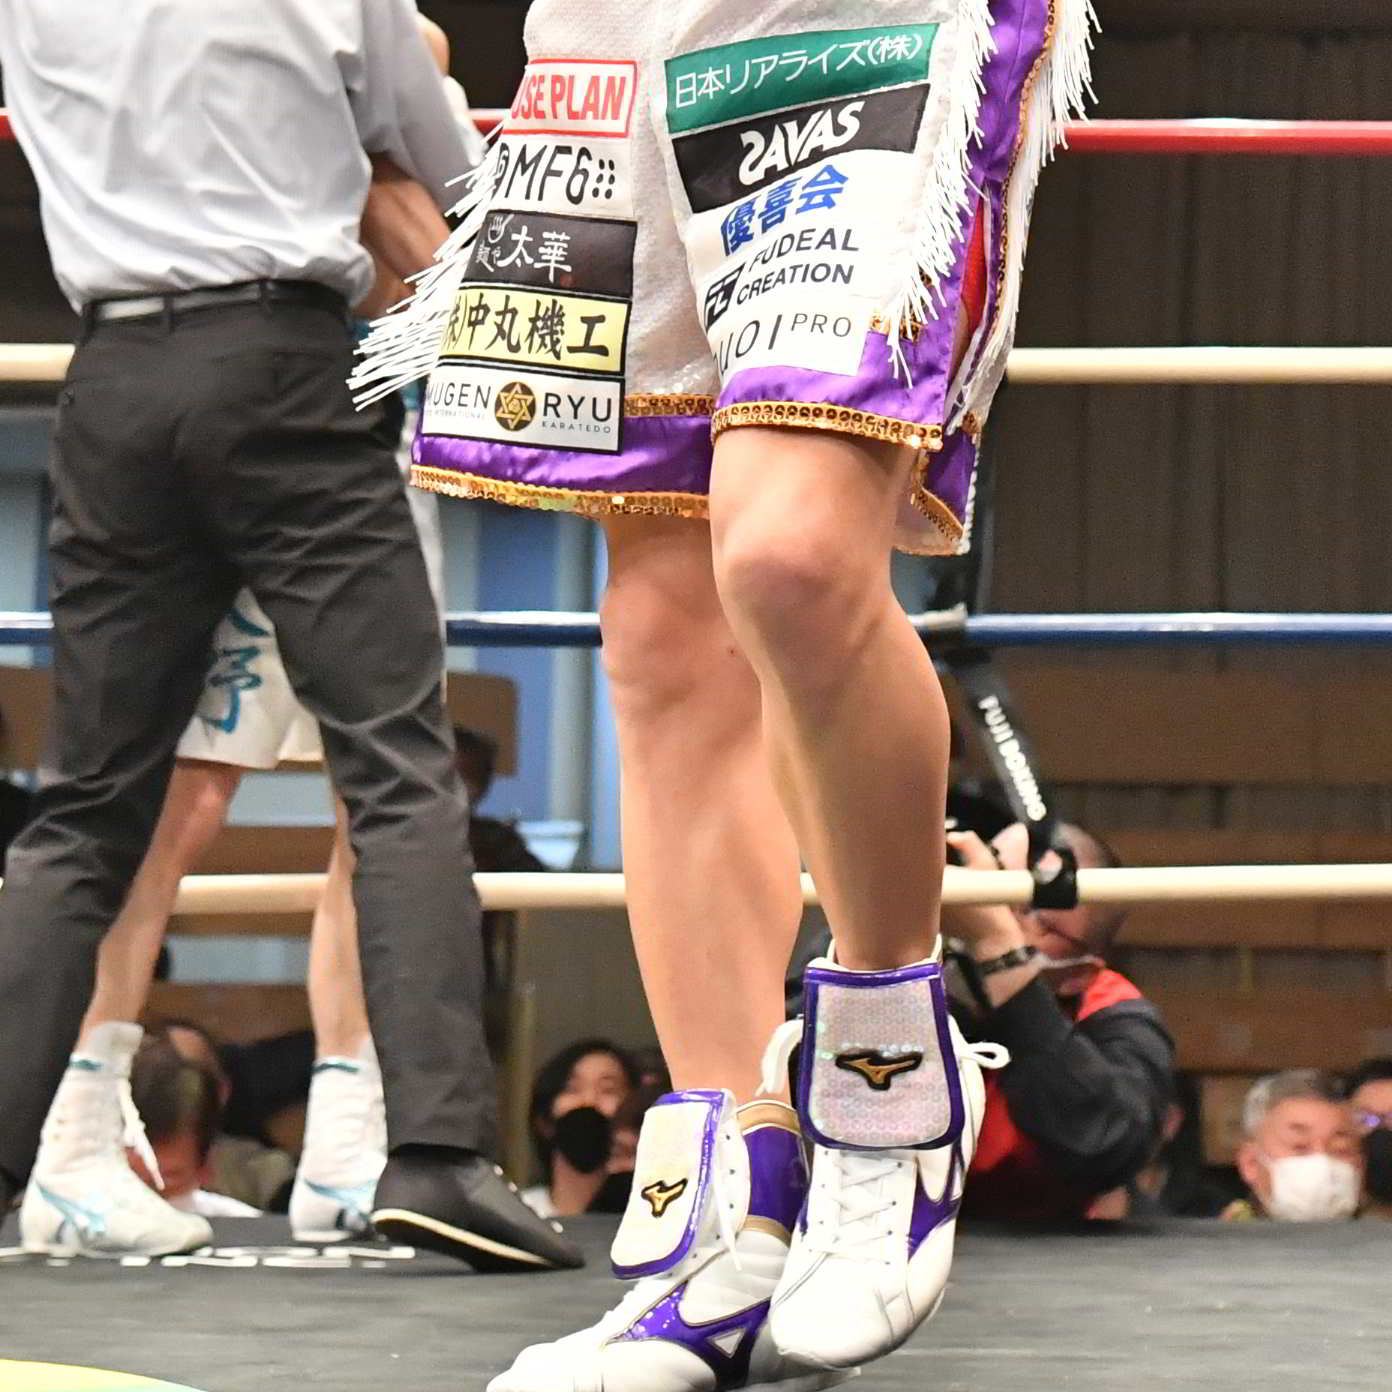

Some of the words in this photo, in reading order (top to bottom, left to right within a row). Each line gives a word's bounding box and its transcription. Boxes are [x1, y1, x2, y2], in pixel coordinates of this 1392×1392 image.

[674, 32, 924, 109] 日本リアライズ(株)
[550, 74, 627, 121] PLAN
[738, 100, 866, 186] SAVAS
[720, 164, 850, 257] 優喜会
[736, 262, 855, 305] CREATION
[790, 312, 852, 338] PRO
[541, 419, 612, 435] KARATEDO
[542, 391, 613, 423] RYU
